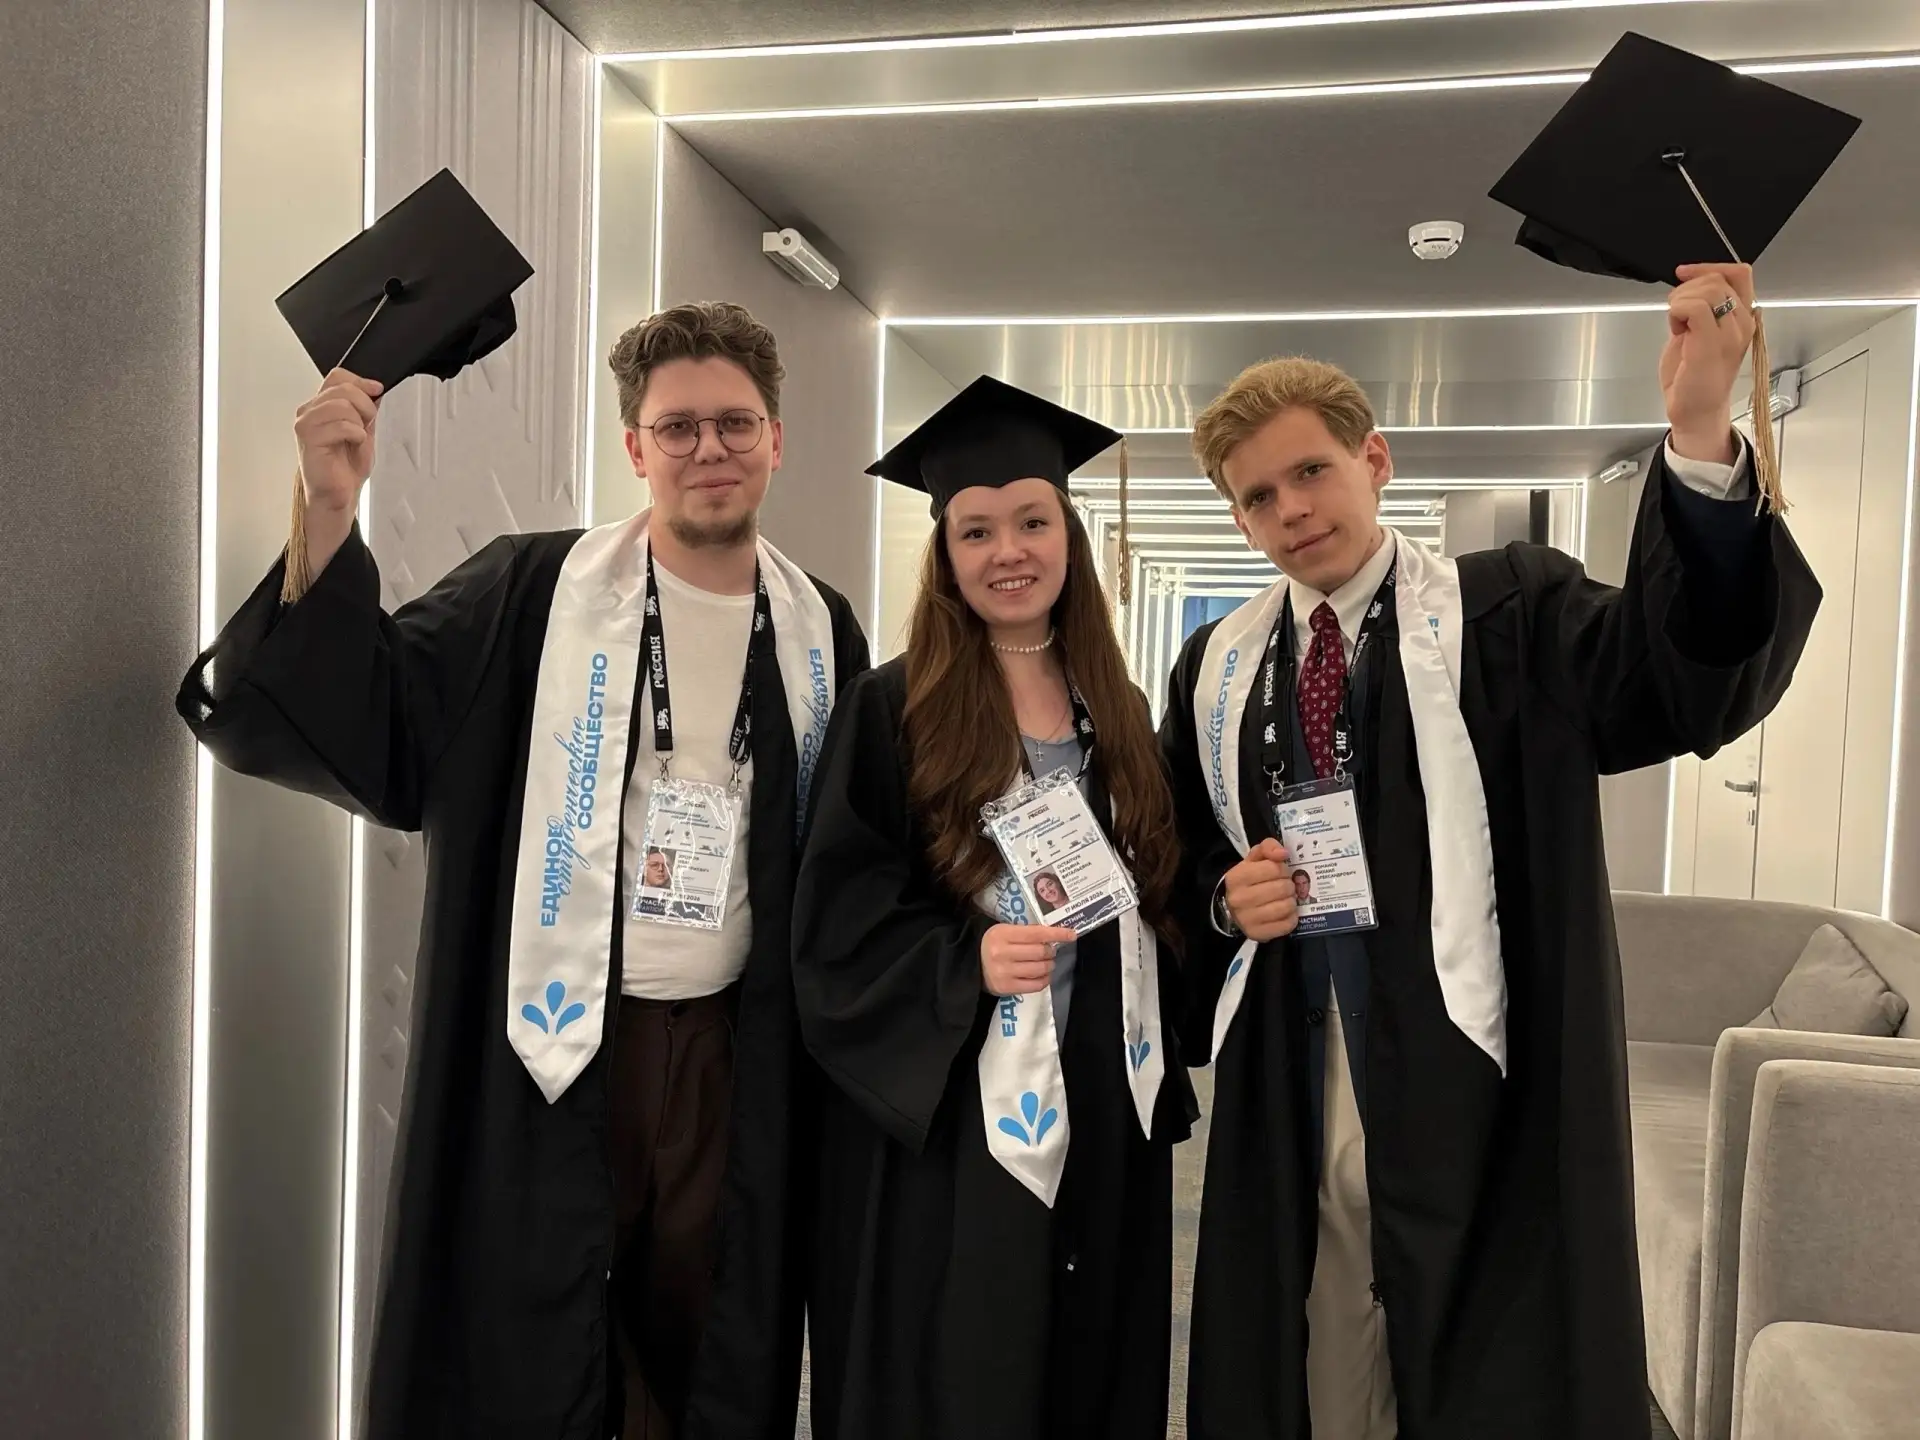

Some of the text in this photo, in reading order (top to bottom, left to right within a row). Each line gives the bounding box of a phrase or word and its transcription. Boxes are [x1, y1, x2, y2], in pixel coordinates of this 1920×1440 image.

[577, 653, 608, 830] СООБЩЕСТВО
[1212, 649, 1239, 807] СООБЩЕСТВО
[541, 823, 565, 927] ЕДИНОЕ
[1070, 897, 1090, 910] ИЮЛЯ
[1088, 890, 1104, 900] 2026
[1316, 870, 1356, 880] АЛЕКСАНДРОВИЧ
[1298, 921, 1328, 930] ARTICIPANT
